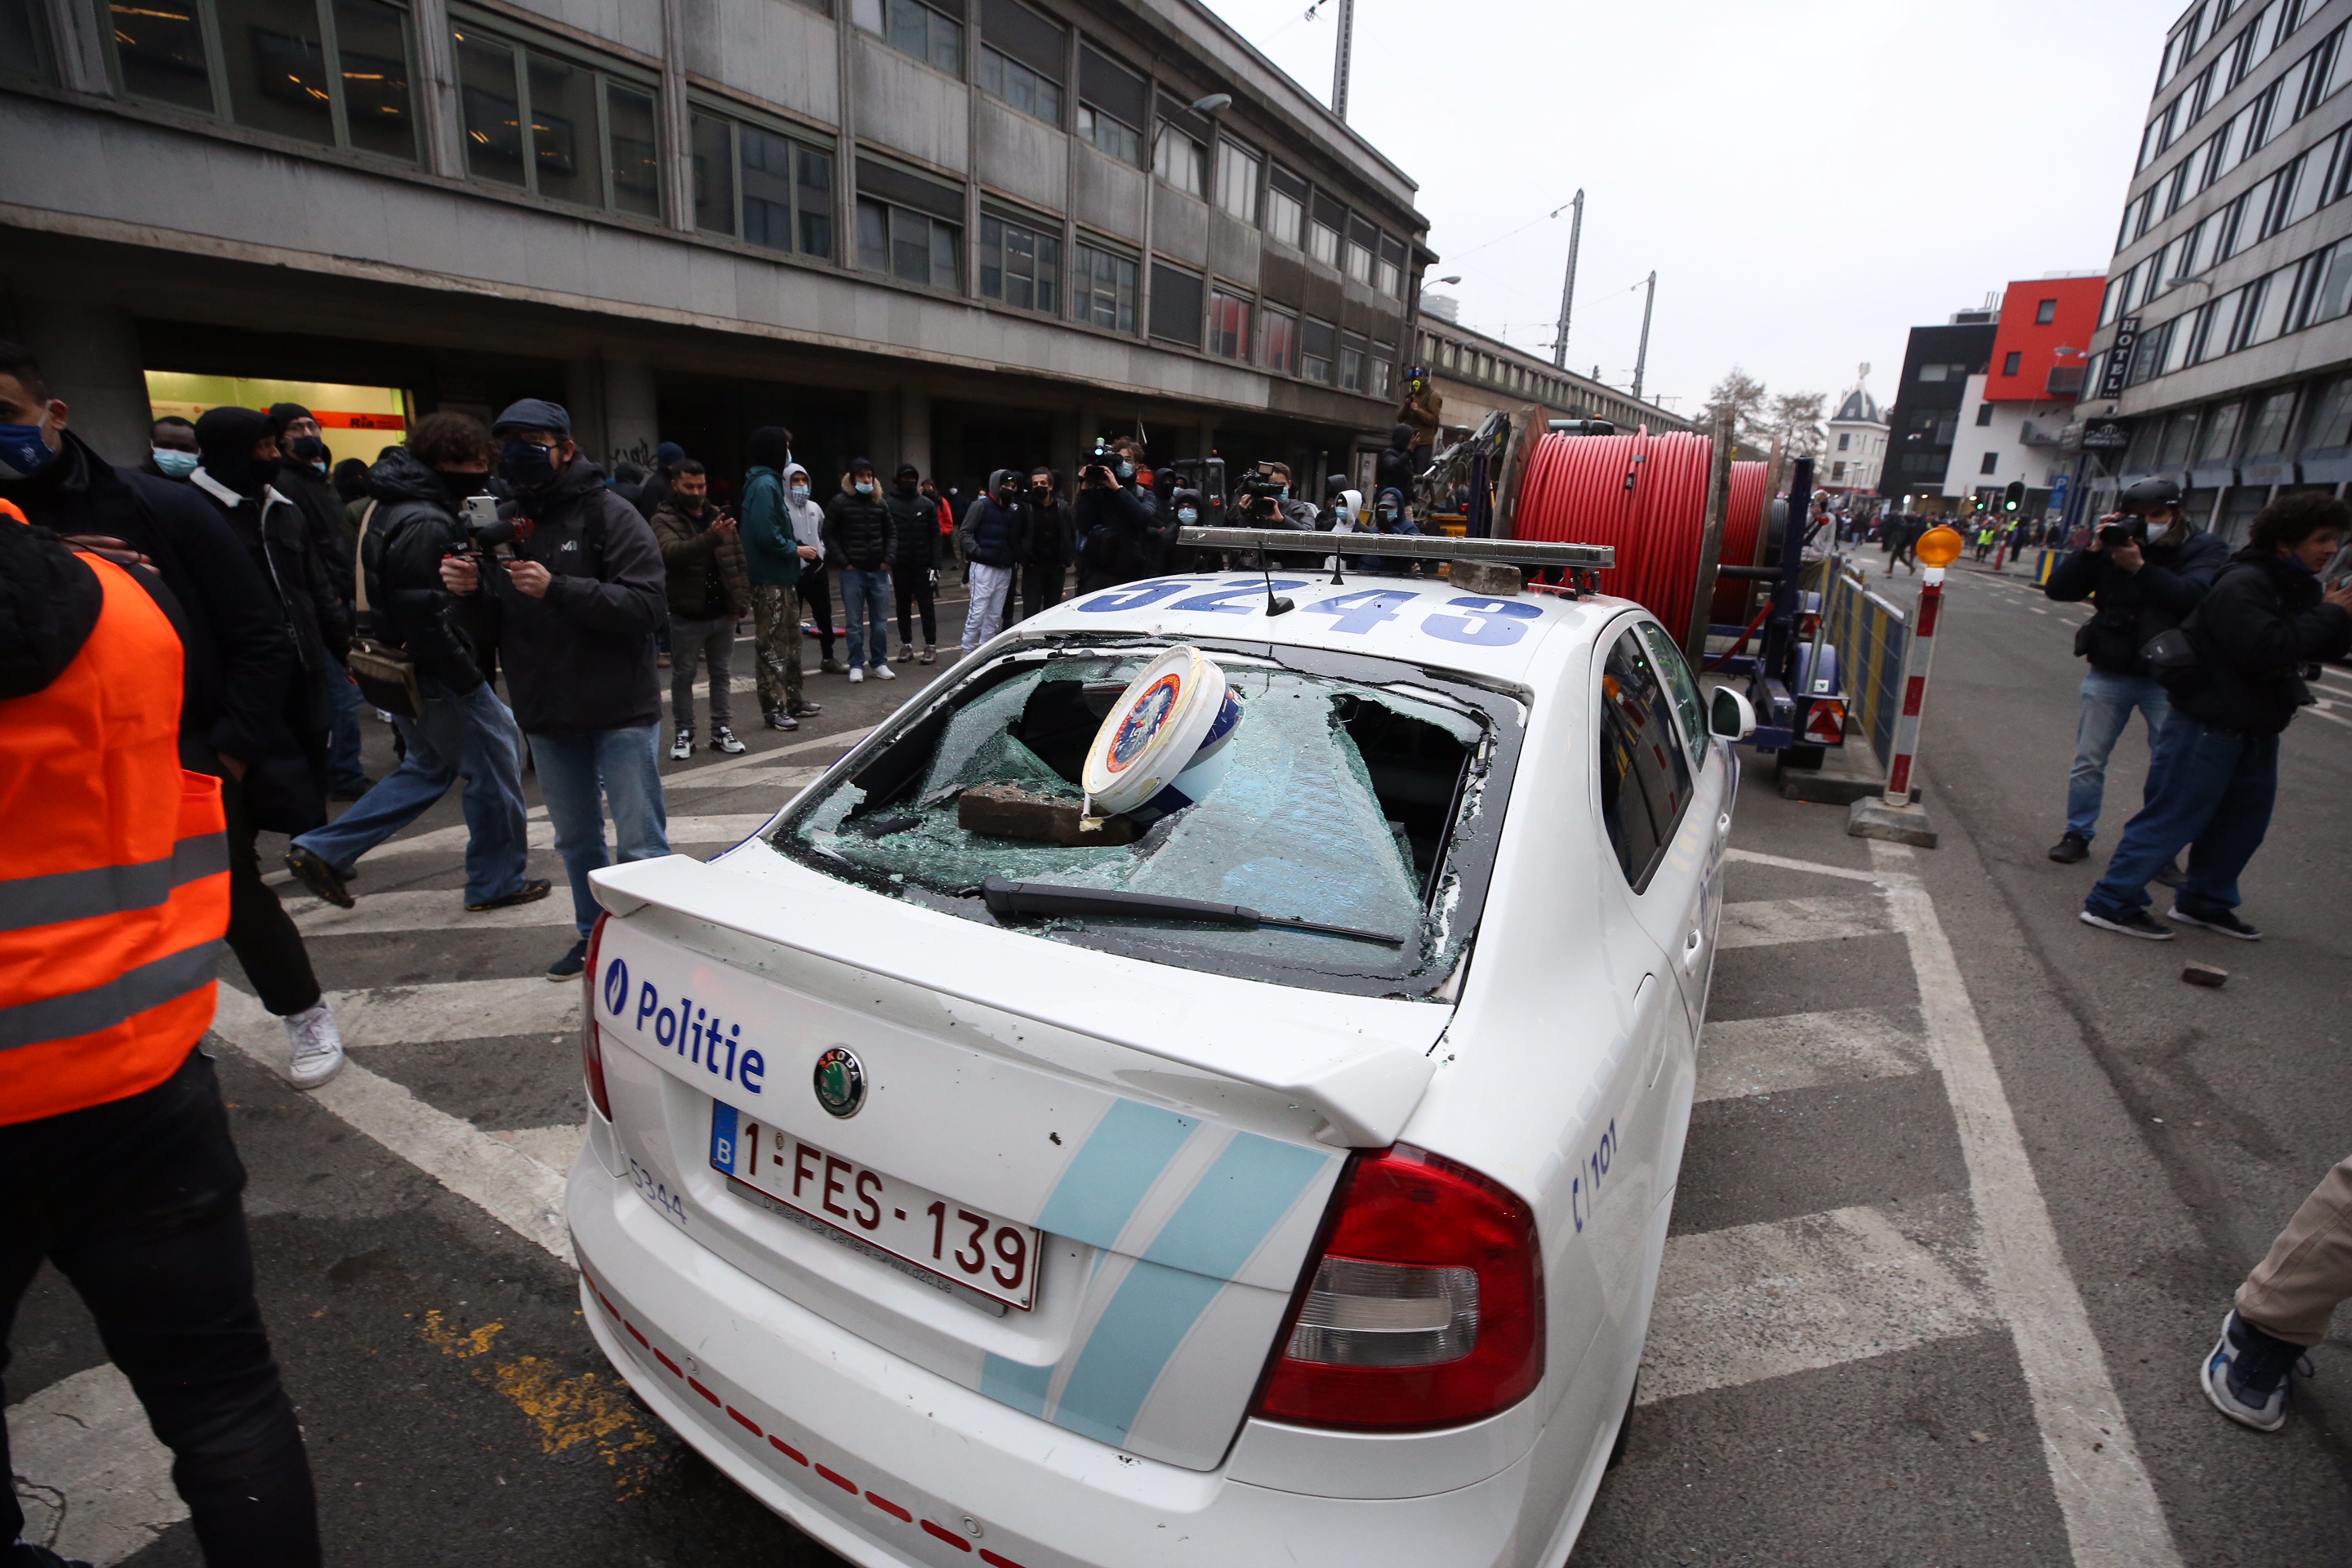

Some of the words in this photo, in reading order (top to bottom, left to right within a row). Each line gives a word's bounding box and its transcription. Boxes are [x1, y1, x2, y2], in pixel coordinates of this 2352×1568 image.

[2107, 319, 2137, 390] HOTEL
[350, 414, 375, 429] Ria
[2058, 478, 2067, 489] P
[1077, 578, 1544, 647] 5243
[636, 981, 764, 1094] Politie
[717, 1137, 732, 1165] B
[808, 1216, 828, 1234] Car
